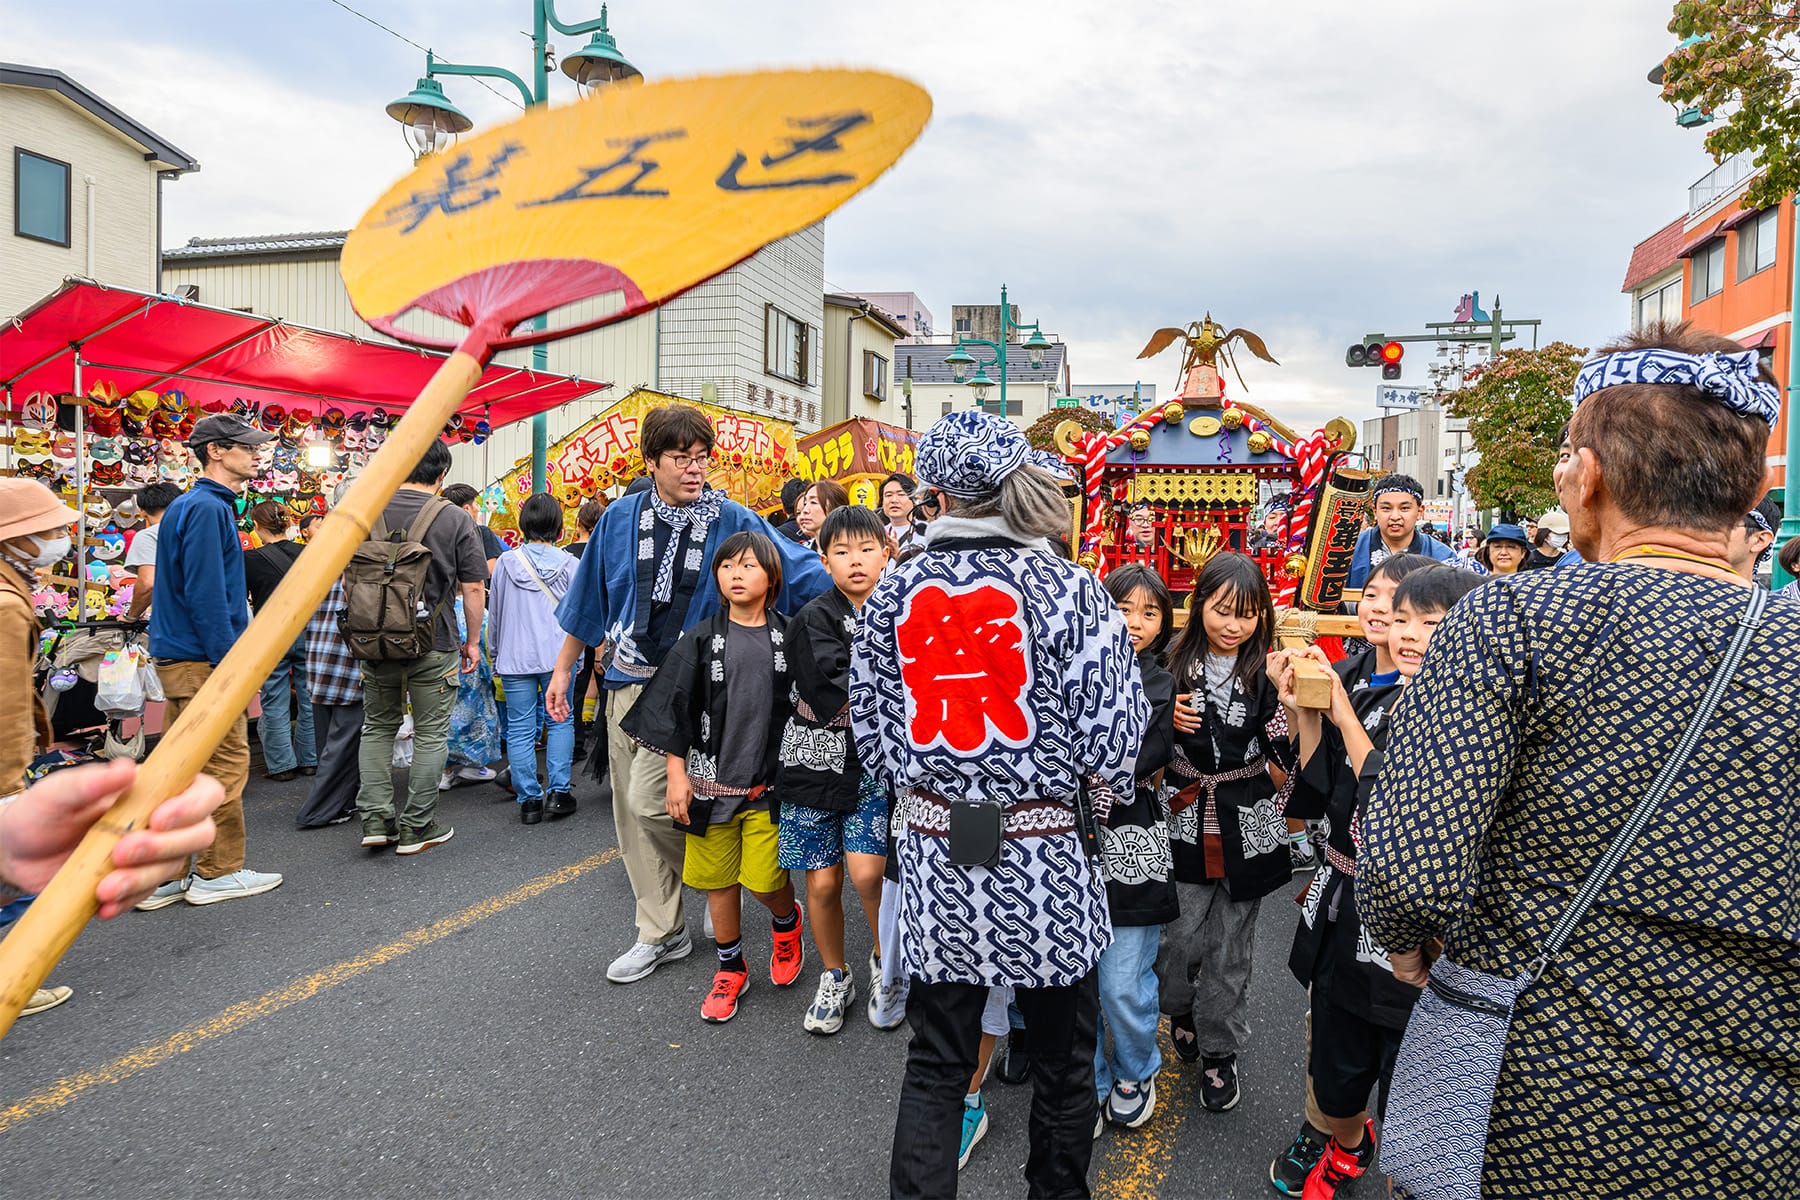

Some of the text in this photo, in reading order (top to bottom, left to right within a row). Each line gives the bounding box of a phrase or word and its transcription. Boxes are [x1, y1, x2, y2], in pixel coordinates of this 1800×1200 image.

[558, 412, 638, 484] ポテト
[715, 414, 770, 456] ポテト
[877, 436, 917, 475] ベビーカ
[897, 585, 1029, 751] 祭
